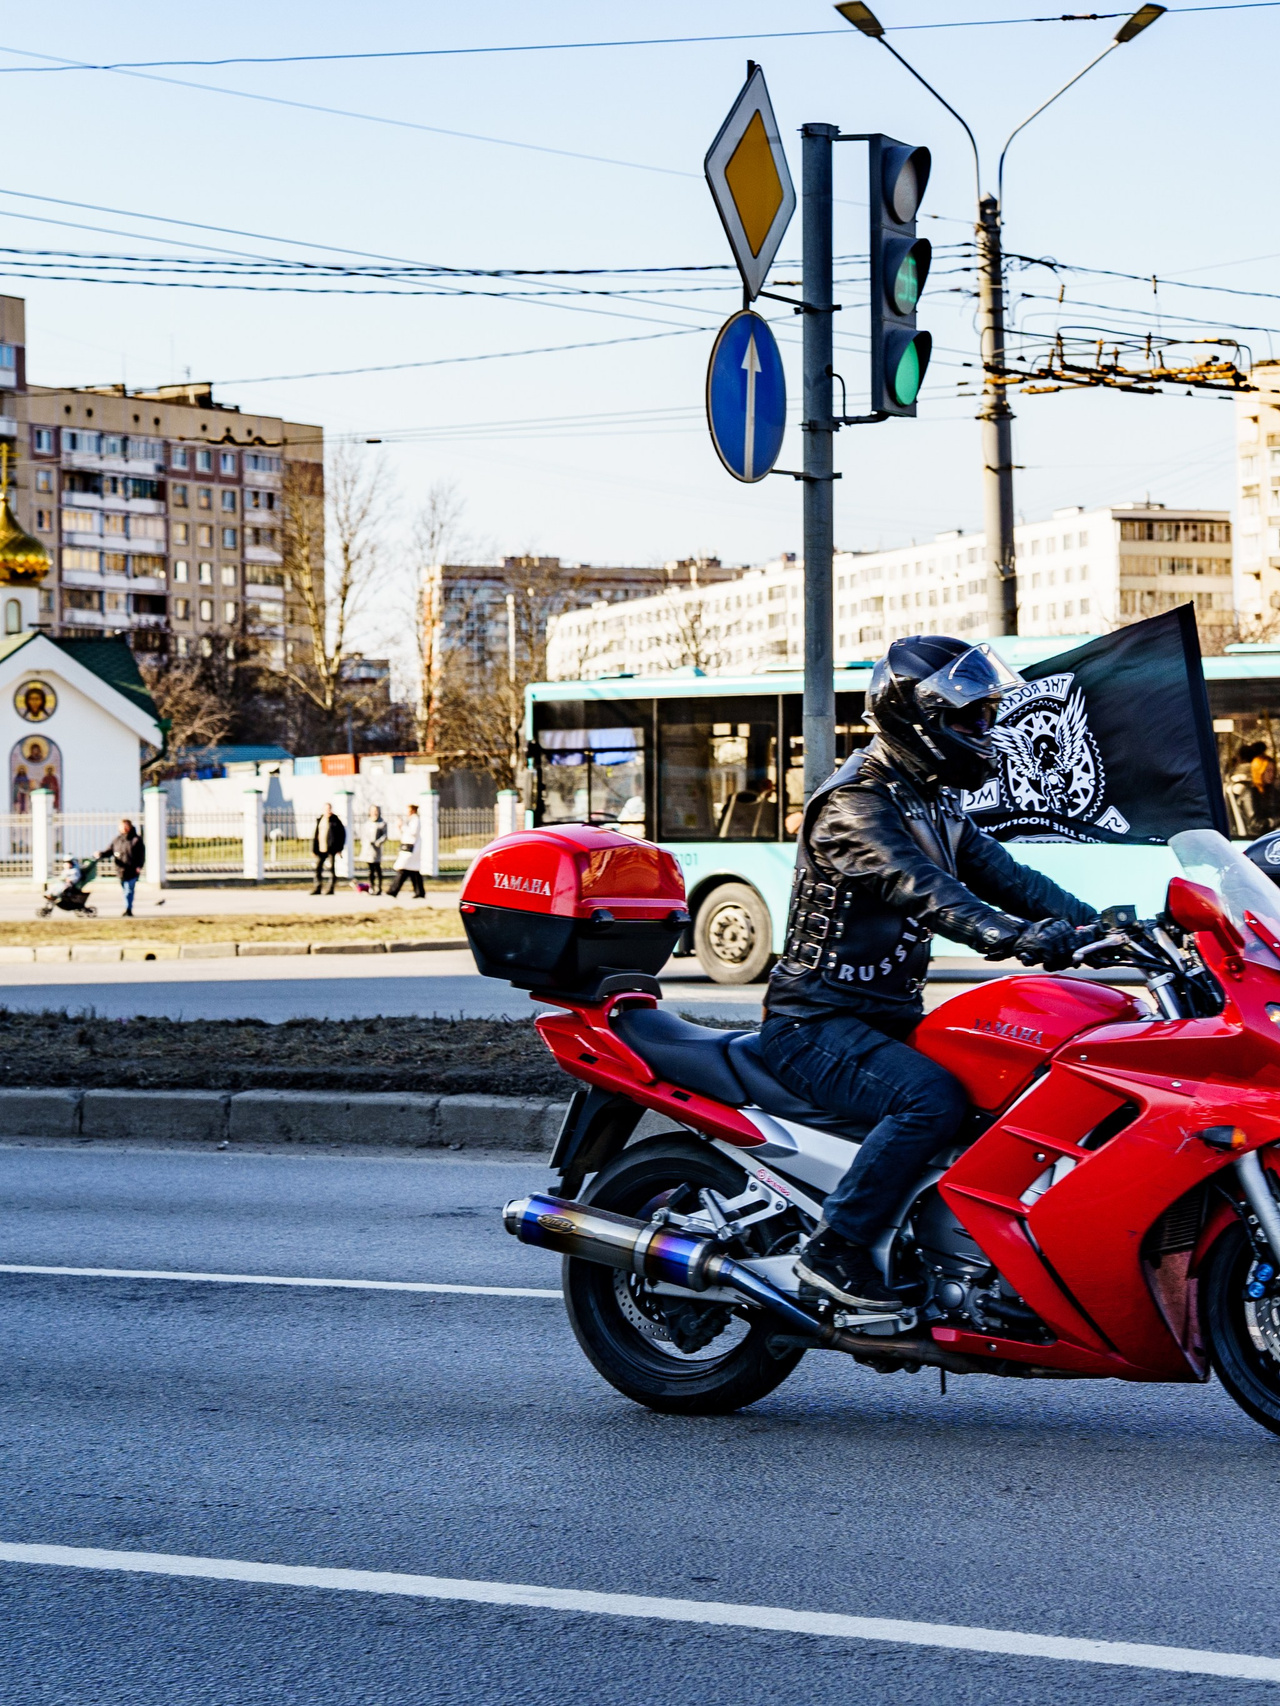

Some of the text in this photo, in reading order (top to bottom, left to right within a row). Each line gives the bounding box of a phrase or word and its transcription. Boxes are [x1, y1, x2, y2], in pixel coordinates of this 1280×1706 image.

[1052, 822, 1077, 838] THE
[674, 853, 698, 866] 101
[493, 872, 551, 896] YAMAHA
[972, 1018, 1043, 1044] YAMAHA
